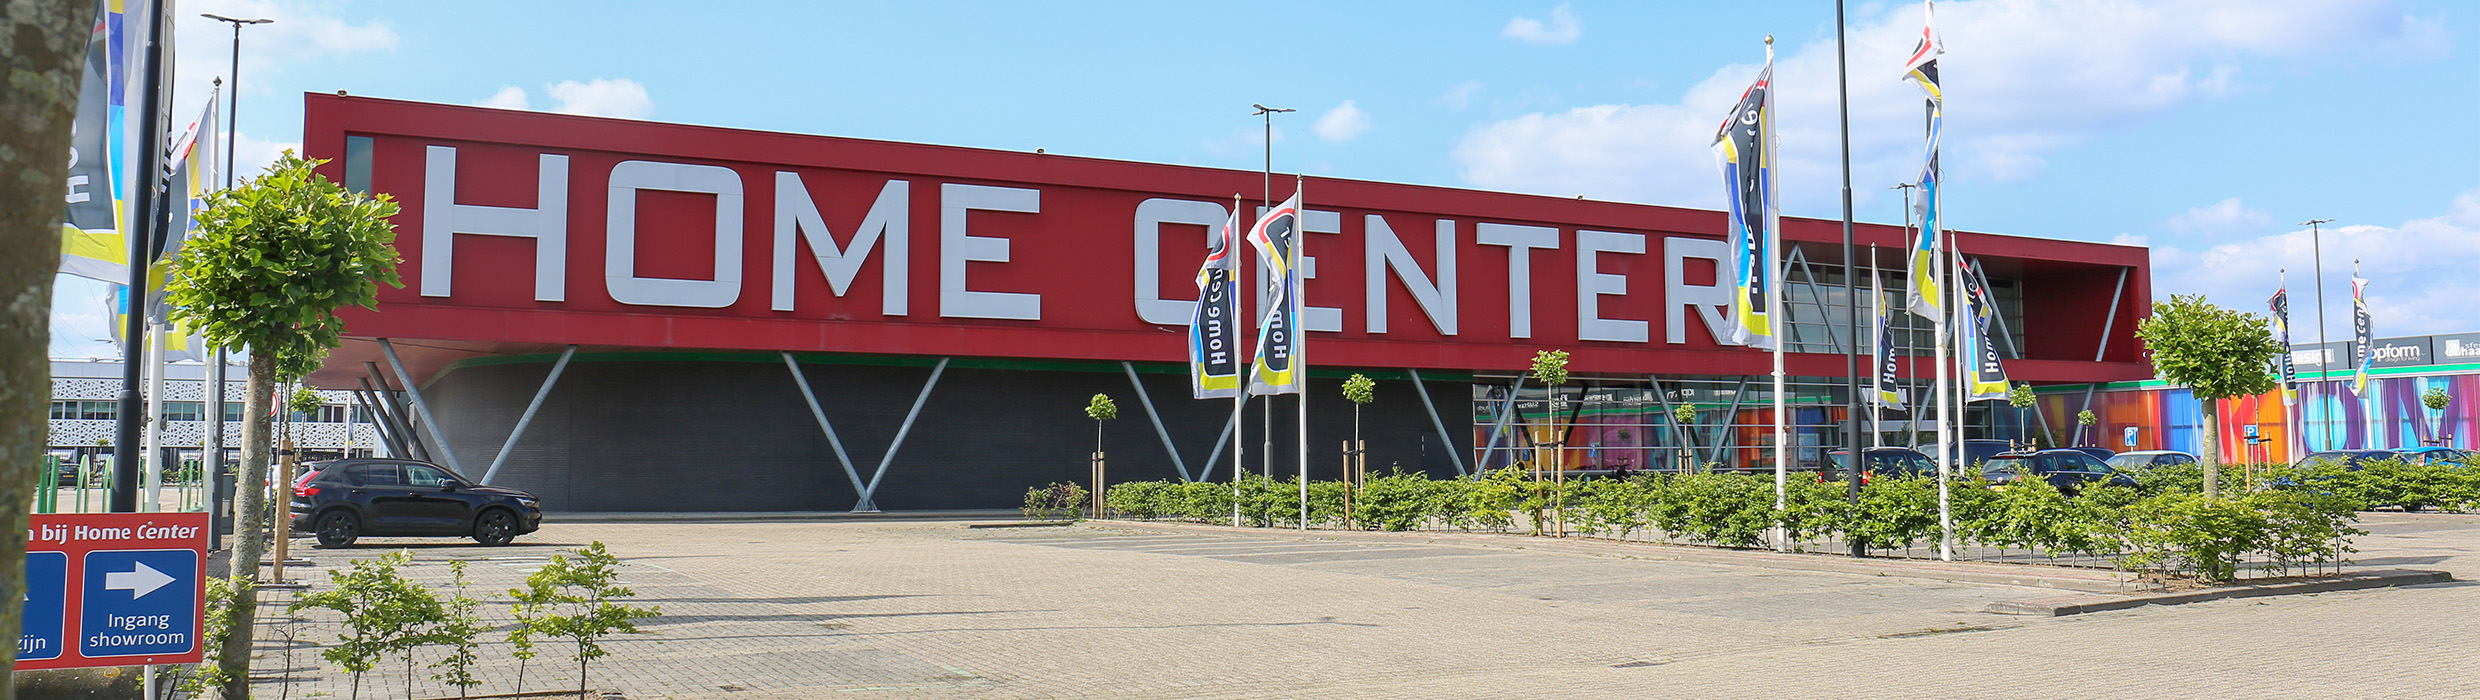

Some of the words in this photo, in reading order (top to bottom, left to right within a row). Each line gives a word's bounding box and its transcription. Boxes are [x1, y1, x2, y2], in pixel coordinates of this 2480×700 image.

[420, 145, 1041, 321] HOME
[1134, 197, 1739, 346] CENTER
[1882, 347, 1897, 384] Hom
[41, 524, 68, 545] bij
[74, 525, 131, 540] Home
[137, 524, 199, 540] Center
[108, 613, 170, 631] Ingang
[89, 632, 185, 648] showroom
